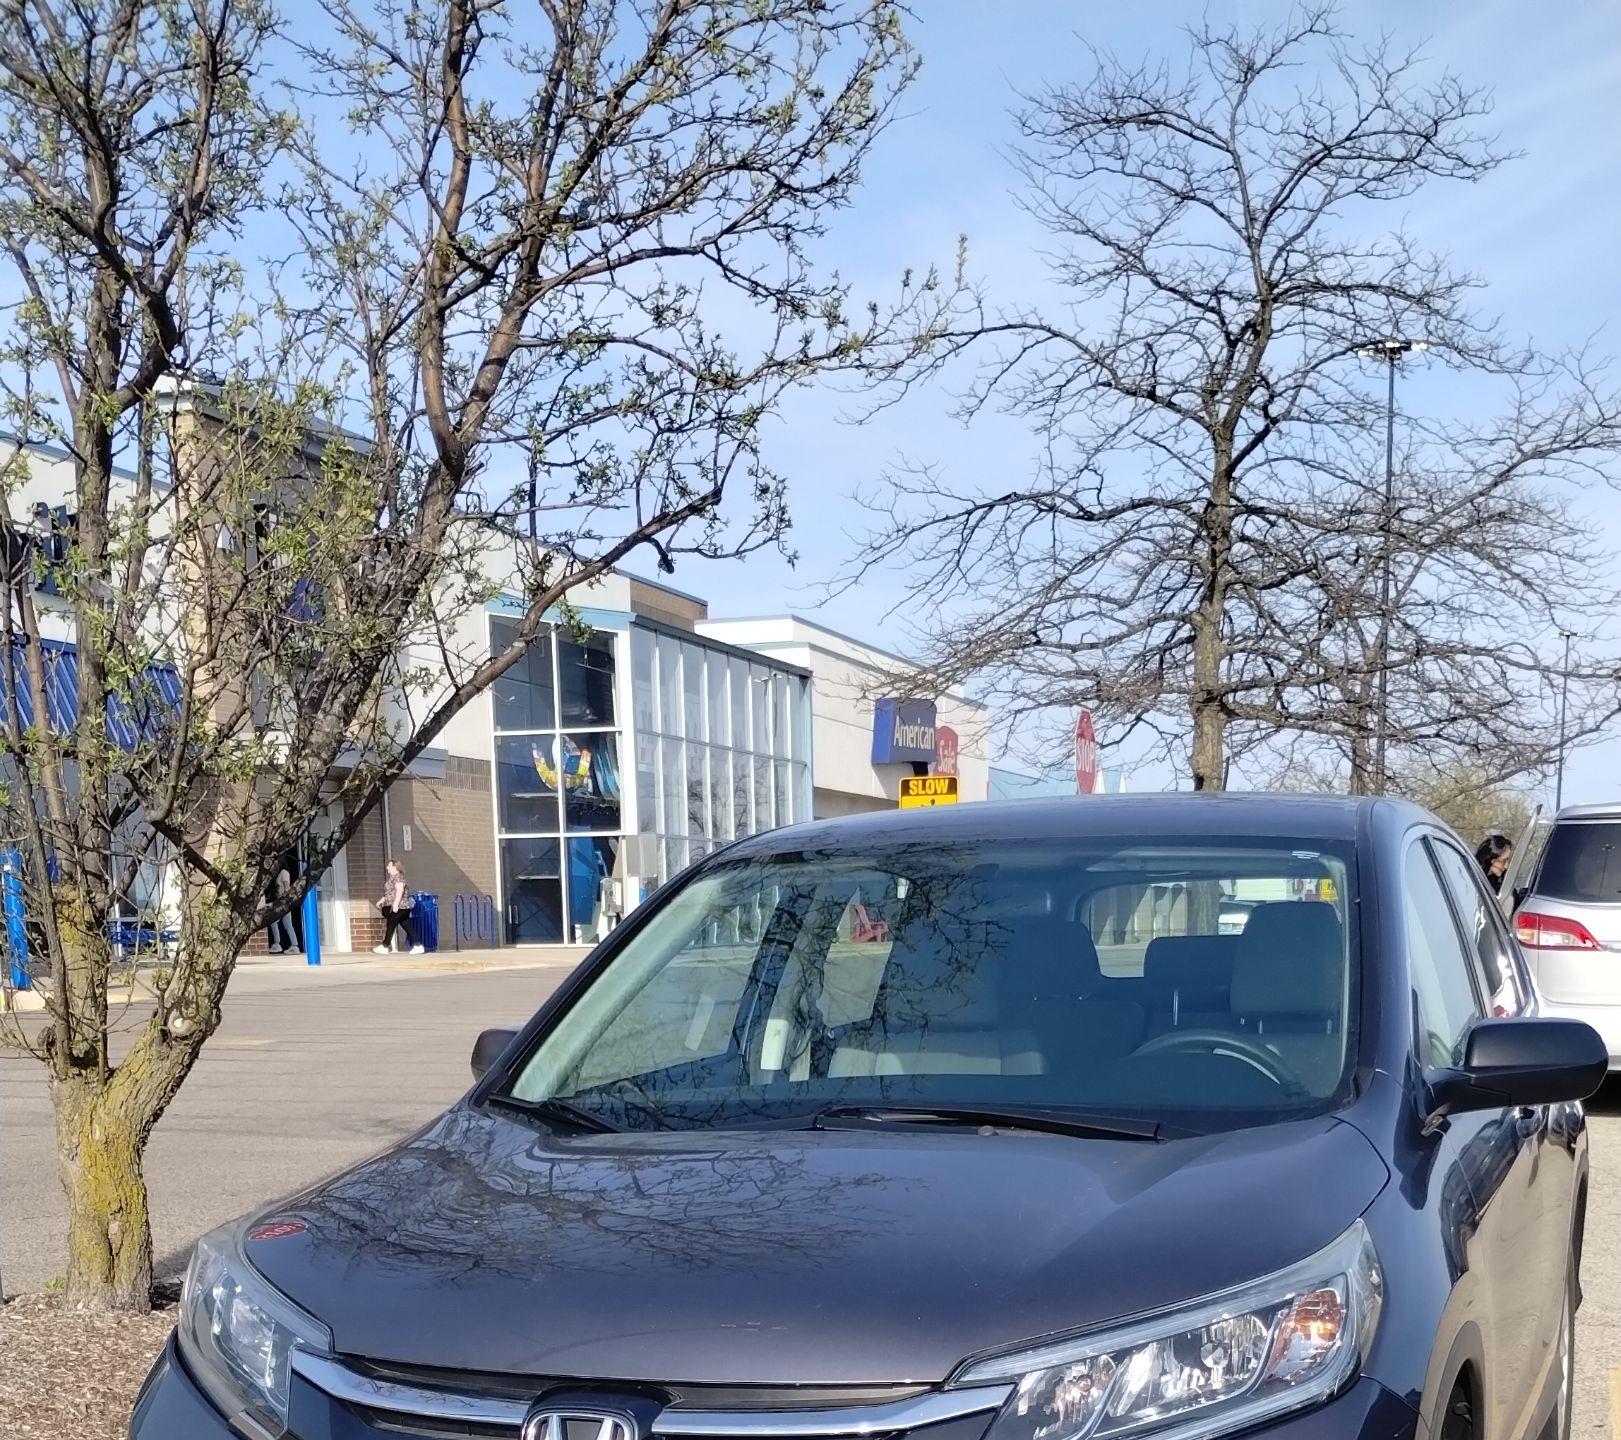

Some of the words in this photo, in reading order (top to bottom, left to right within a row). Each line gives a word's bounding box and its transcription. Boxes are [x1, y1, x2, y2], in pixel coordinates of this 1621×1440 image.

[894, 714, 935, 751] American
[1077, 737, 1095, 773] STOP
[909, 778, 949, 796] SLOW
